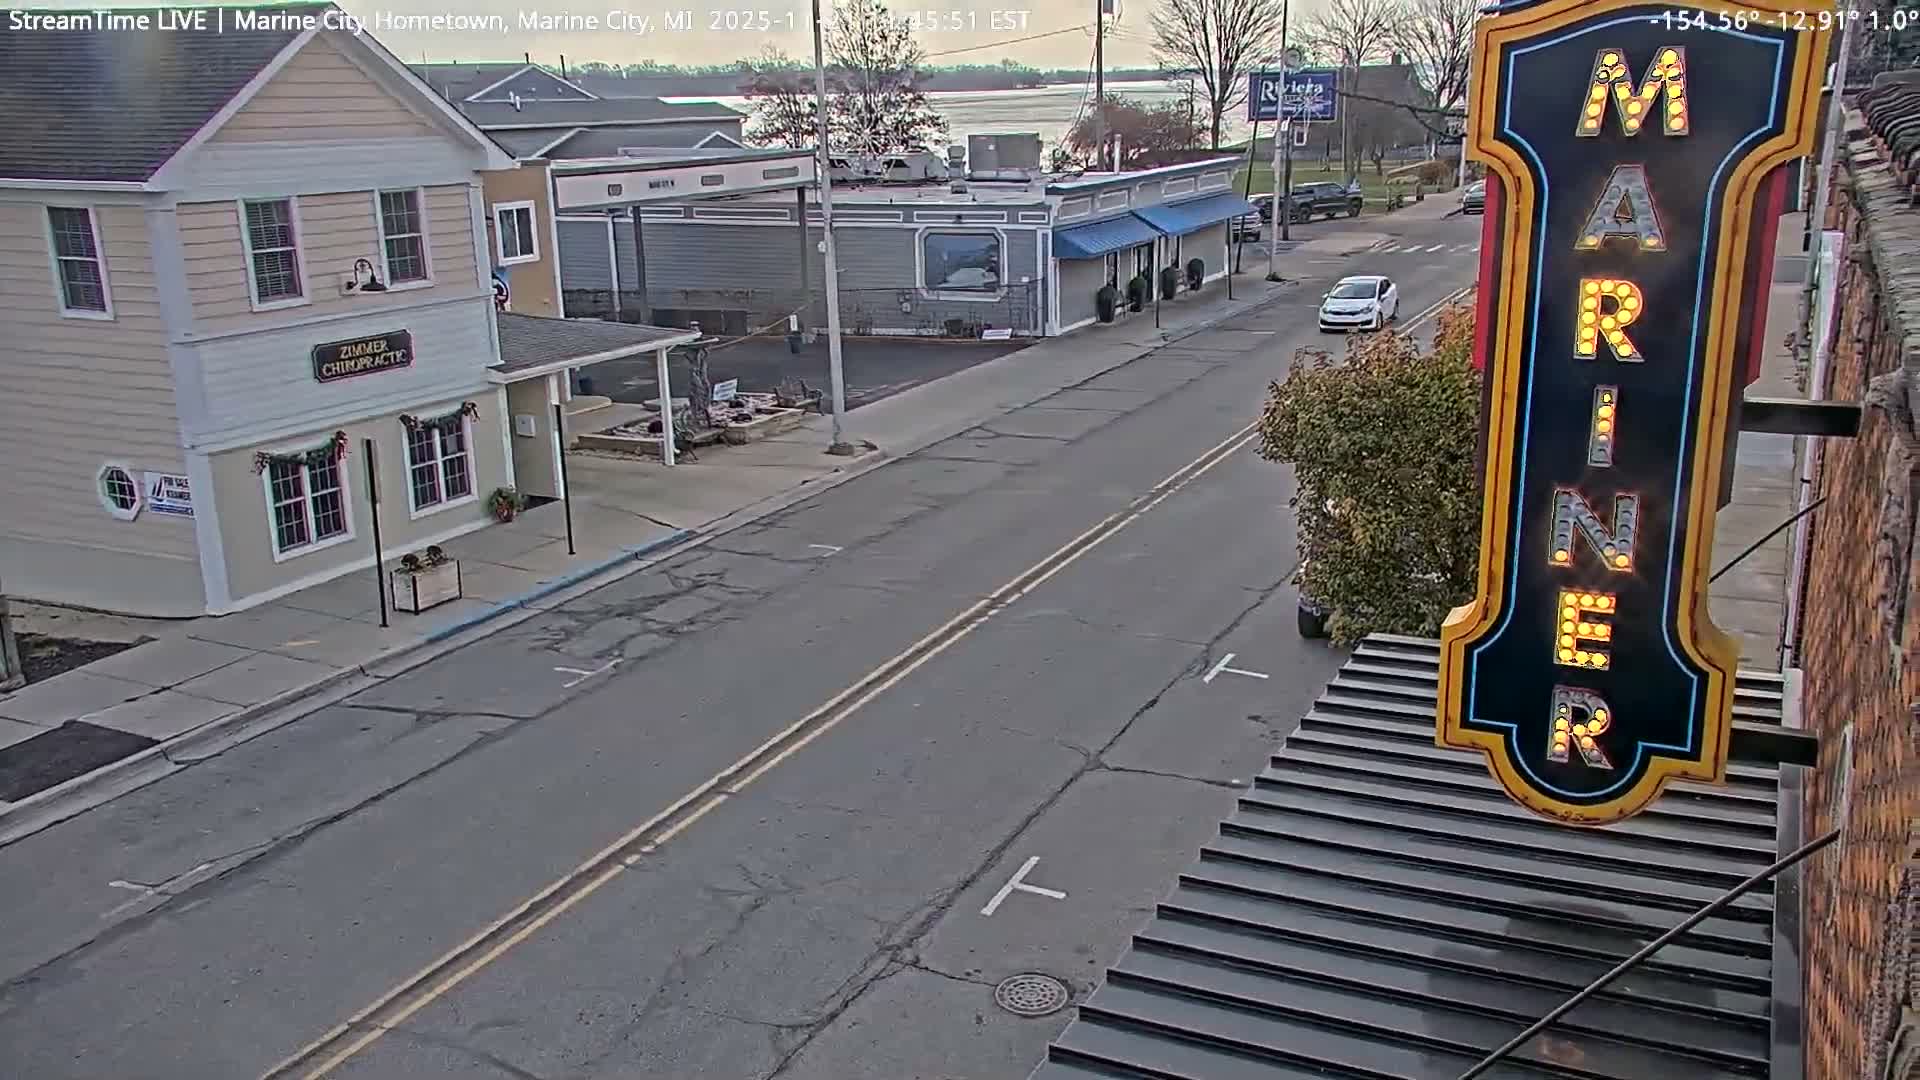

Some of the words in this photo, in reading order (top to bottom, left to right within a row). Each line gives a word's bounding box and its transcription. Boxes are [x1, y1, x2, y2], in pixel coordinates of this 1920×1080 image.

[322, 349, 407, 377] CHIROPRACTIC
[339, 340, 390, 359] ZIMMER
[1546, 45, 1690, 771] MARINER
